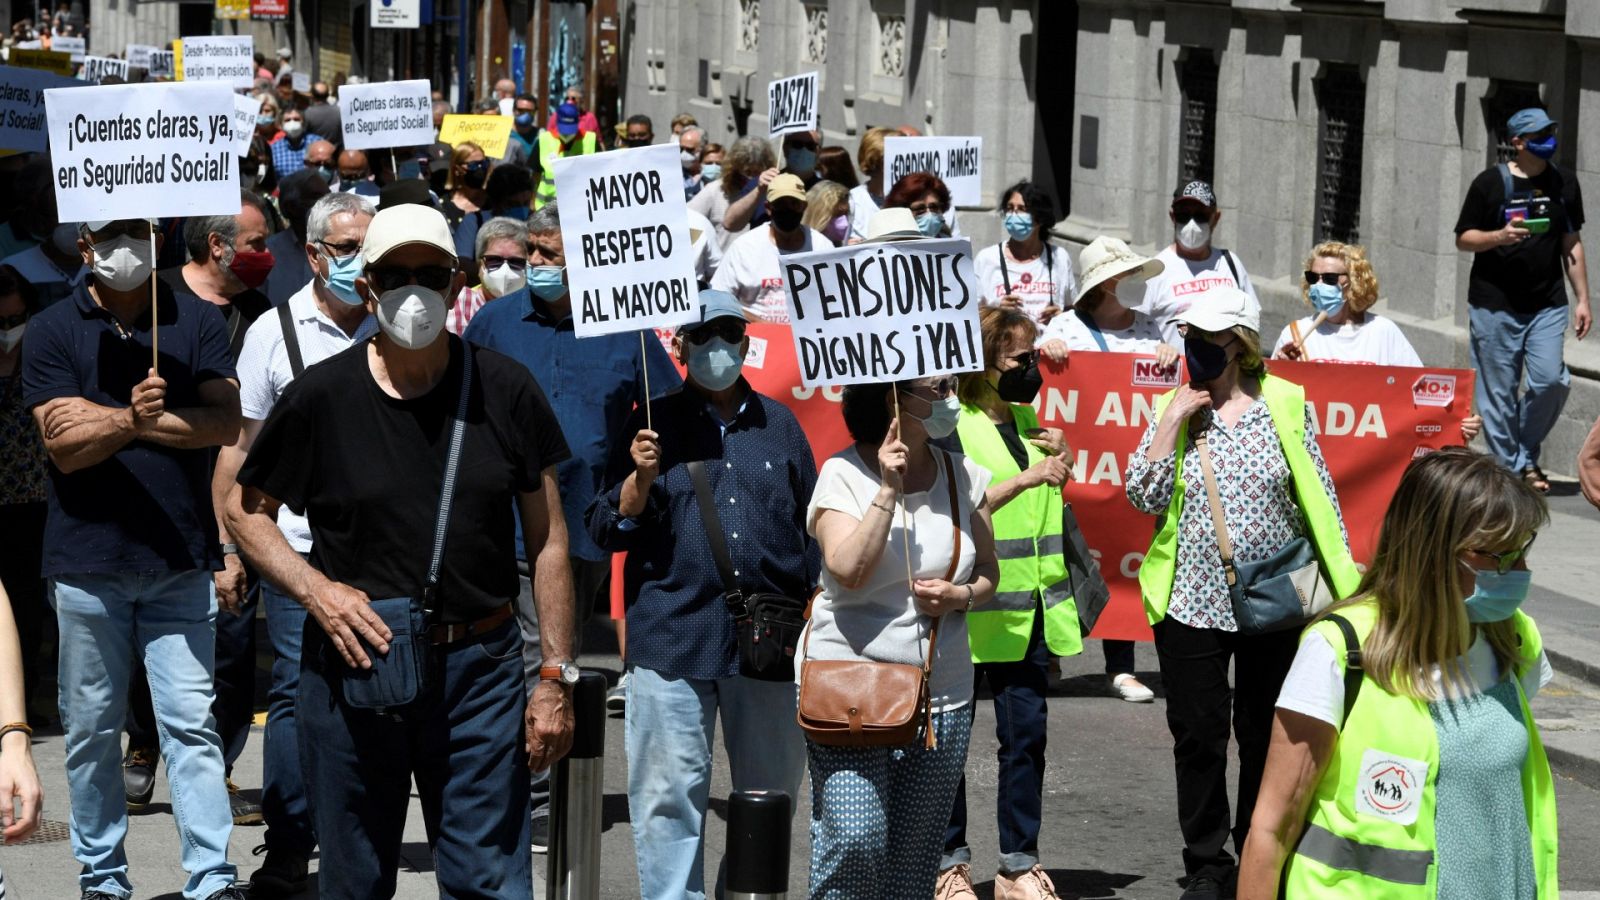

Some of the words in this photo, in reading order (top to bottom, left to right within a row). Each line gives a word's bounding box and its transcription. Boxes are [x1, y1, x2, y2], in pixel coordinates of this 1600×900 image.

[150, 53, 174, 73] ¡BAST
[184, 44, 203, 57] Desde
[205, 44, 233, 57] Podemos
[240, 44, 251, 56] Vox
[186, 63, 204, 80] exijo
[206, 63, 216, 76] mi
[218, 63, 252, 80] pensión.
[350, 97, 387, 116] ¡Cuentas
[389, 95, 416, 109] claras,
[418, 96, 430, 111] ya,
[771, 76, 814, 127] ¡BASTA!
[8, 110, 44, 132] Social!
[68, 113, 142, 151] ¡Cuentas
[147, 110, 204, 143] claras,
[209, 114, 234, 144] ya,
[345, 122, 355, 134] en
[357, 115, 399, 136] Seguridad
[401, 114, 429, 130] Social!
[58, 166, 78, 189] en
[83, 154, 166, 194] Seguridad
[171, 152, 230, 183] Social!
[946, 140, 978, 178] JAMÁS!
[585, 170, 664, 222] ¡MAYOR
[582, 224, 673, 268] RESPETO
[582, 289, 610, 324] AL
[612, 277, 691, 320] MAYOR!
[786, 248, 970, 320] PENSIONES
[799, 328, 906, 380] DIGNAS
[912, 319, 978, 376] ¡YA!
[1136, 362, 1177, 378] NO+
[1416, 381, 1451, 395] NO+
